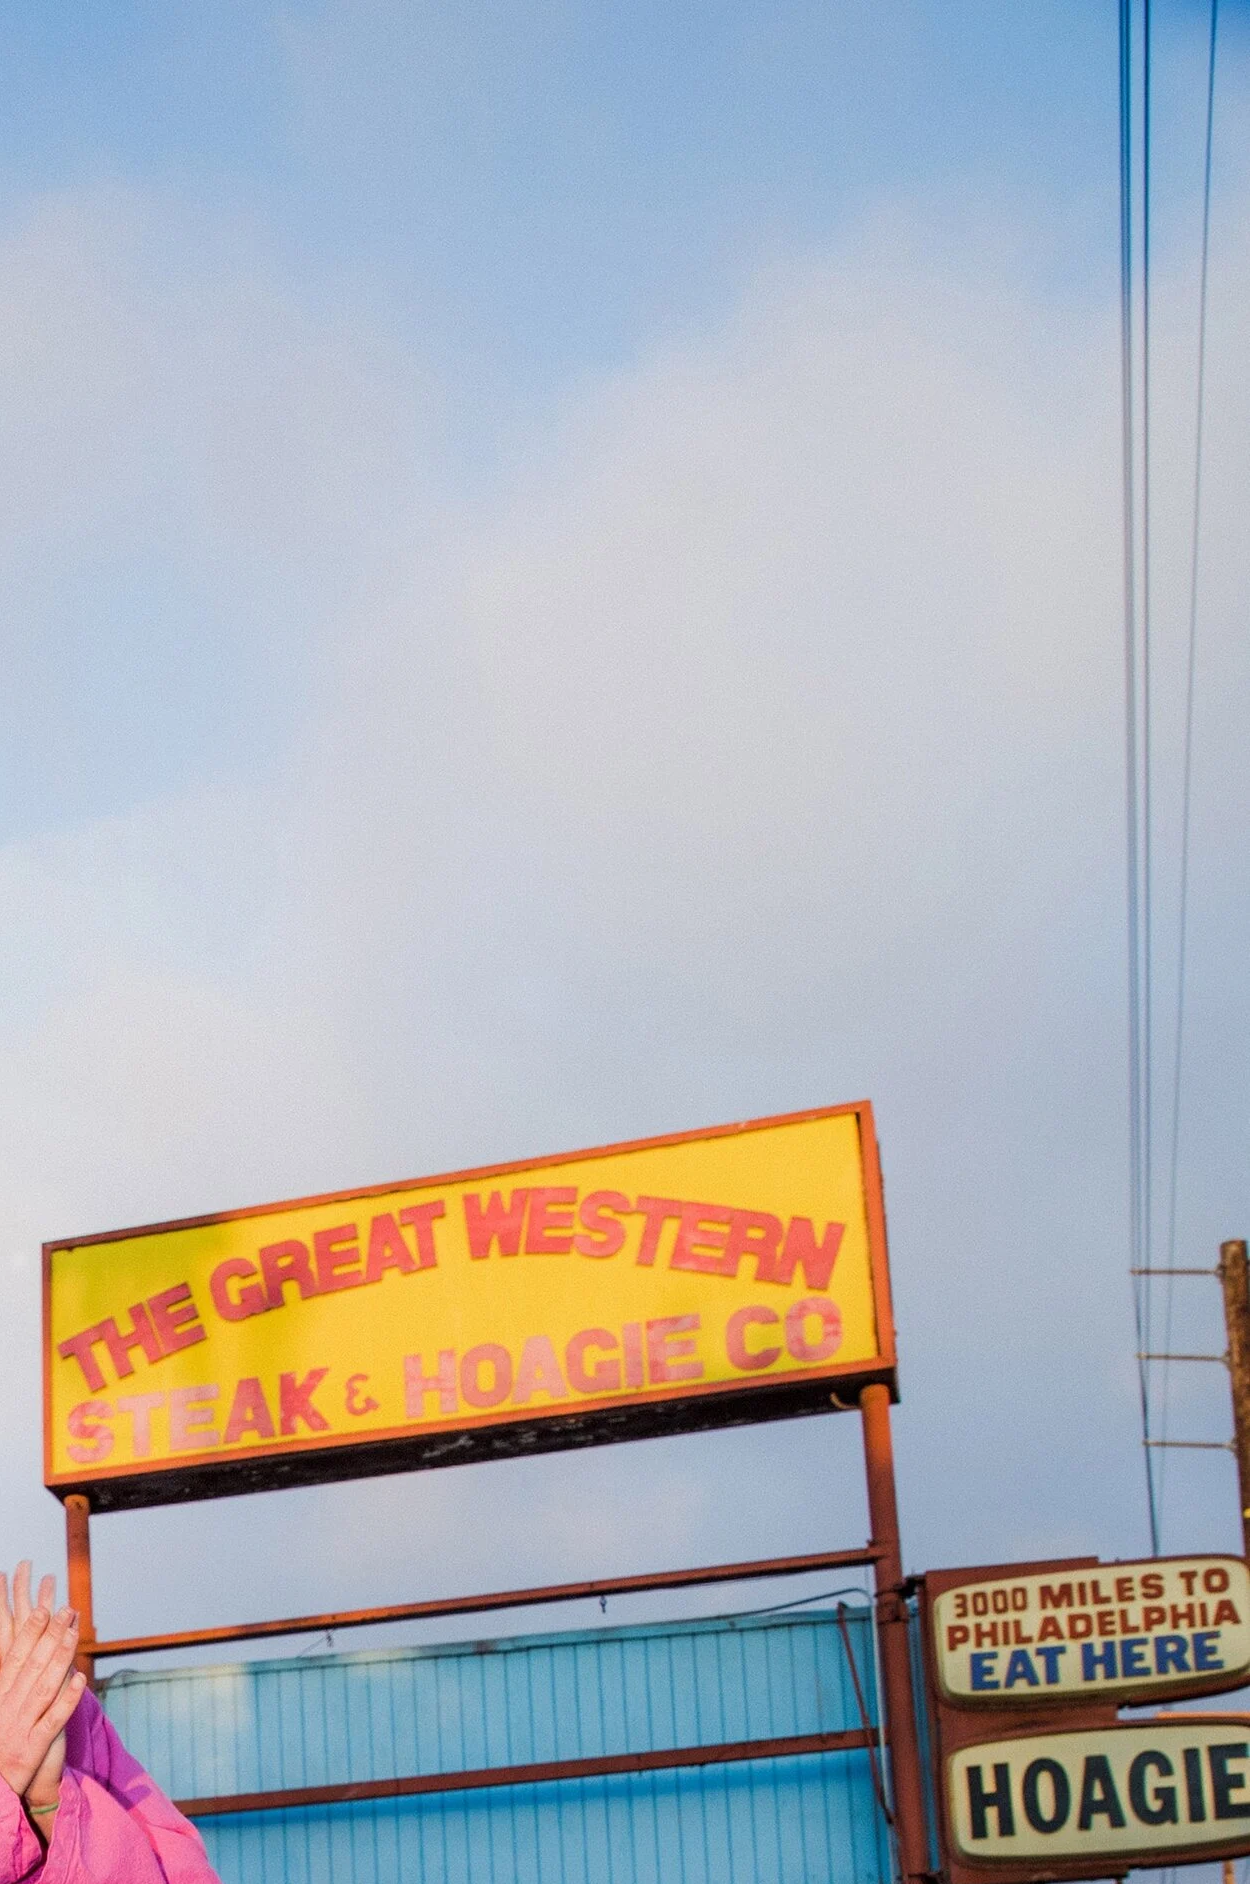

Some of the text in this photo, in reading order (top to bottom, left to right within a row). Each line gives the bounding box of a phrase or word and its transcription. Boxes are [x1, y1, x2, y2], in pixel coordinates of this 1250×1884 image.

[58, 1186, 846, 1391] THE GREAT WESTERN
[65, 1296, 843, 1466] STEAK & HOAGIE CO
[954, 1568, 1230, 1619] 3000 MILES TO
[946, 1600, 1242, 1652] PHILADELPHIA
[969, 1631, 1225, 1691] EAT HERE
